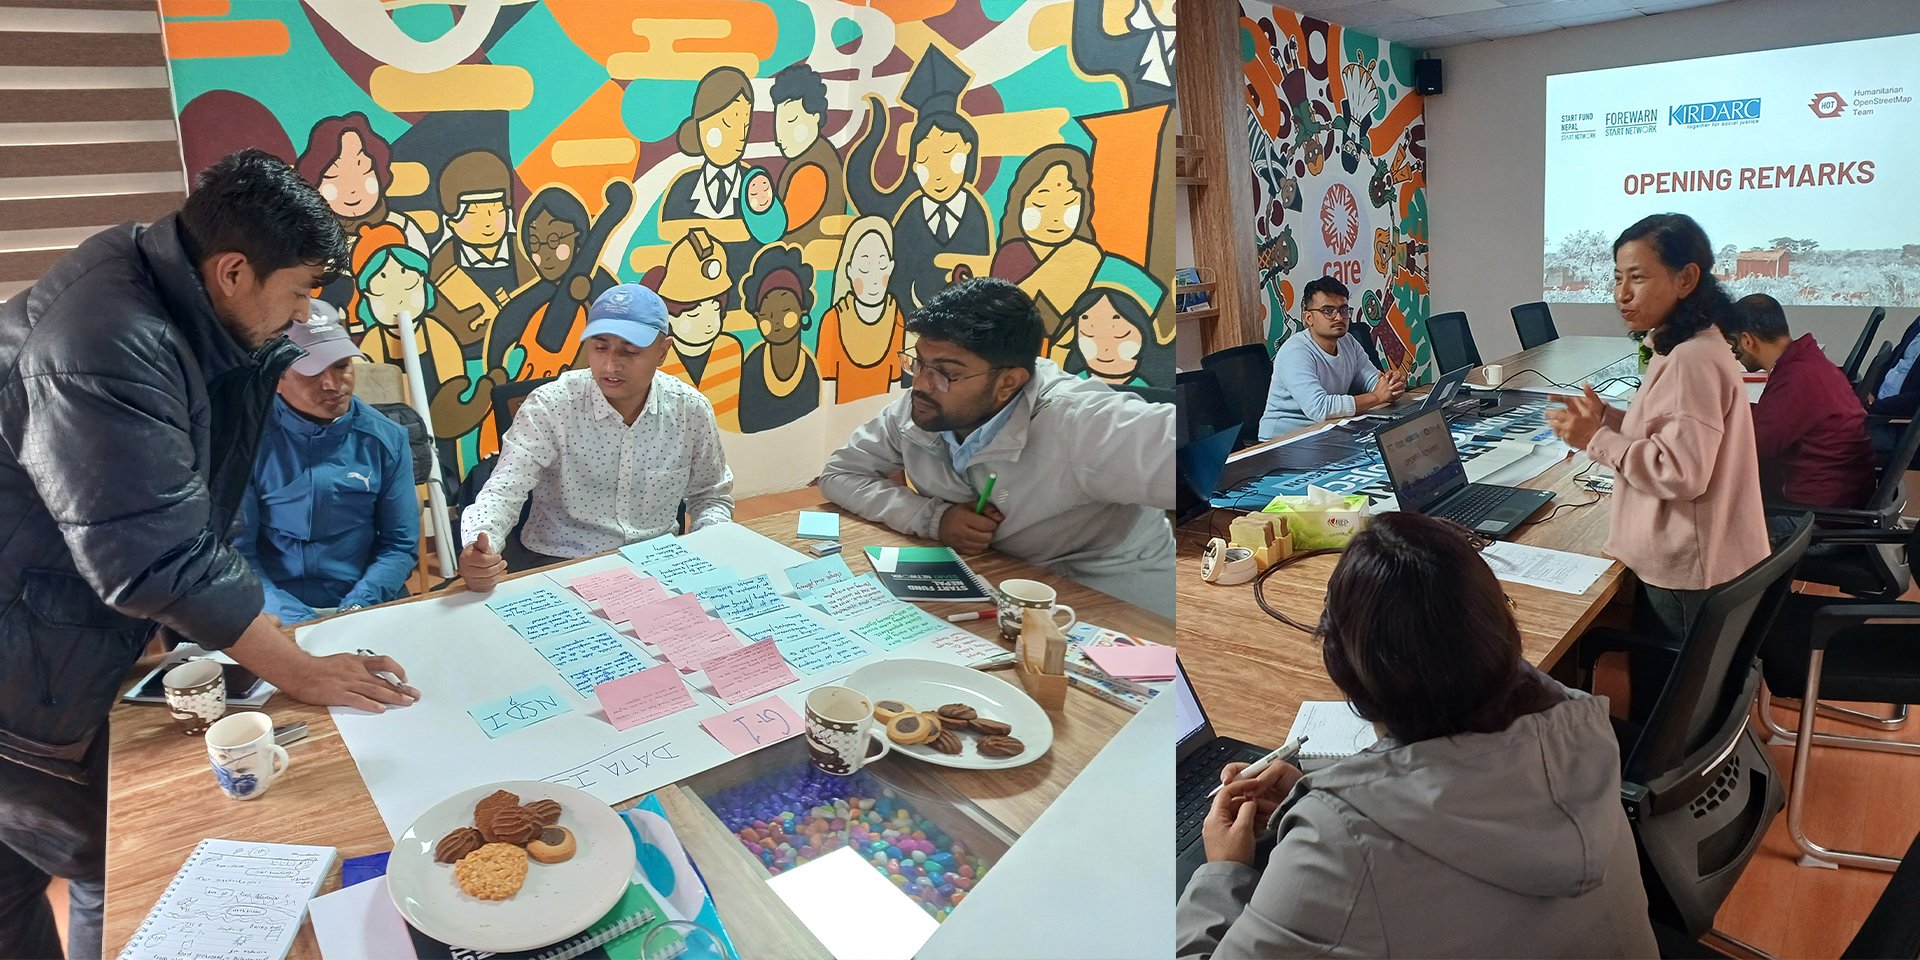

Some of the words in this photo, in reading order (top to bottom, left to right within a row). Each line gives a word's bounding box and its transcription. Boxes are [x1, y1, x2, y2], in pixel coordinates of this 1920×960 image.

[1854, 87, 1904, 96] Humanitarian
[1854, 96, 1912, 107] OpenStreetMap
[1562, 114, 1578, 122] START
[1579, 113, 1594, 121] FUND
[1606, 109, 1658, 126] FOREWARN
[1668, 100, 1760, 126] KIRDARC
[1562, 123, 1578, 131] NEPAL
[1605, 128, 1624, 136] START
[1625, 125, 1657, 135] NETWORK
[1687, 122, 1710, 130] together
[1624, 168, 1732, 195] OPENING
[1739, 160, 1876, 190] REMARKS
[1323, 260, 1361, 284] care
[482, 695, 558, 730] NSDI
[600, 741, 679, 776] DATA
